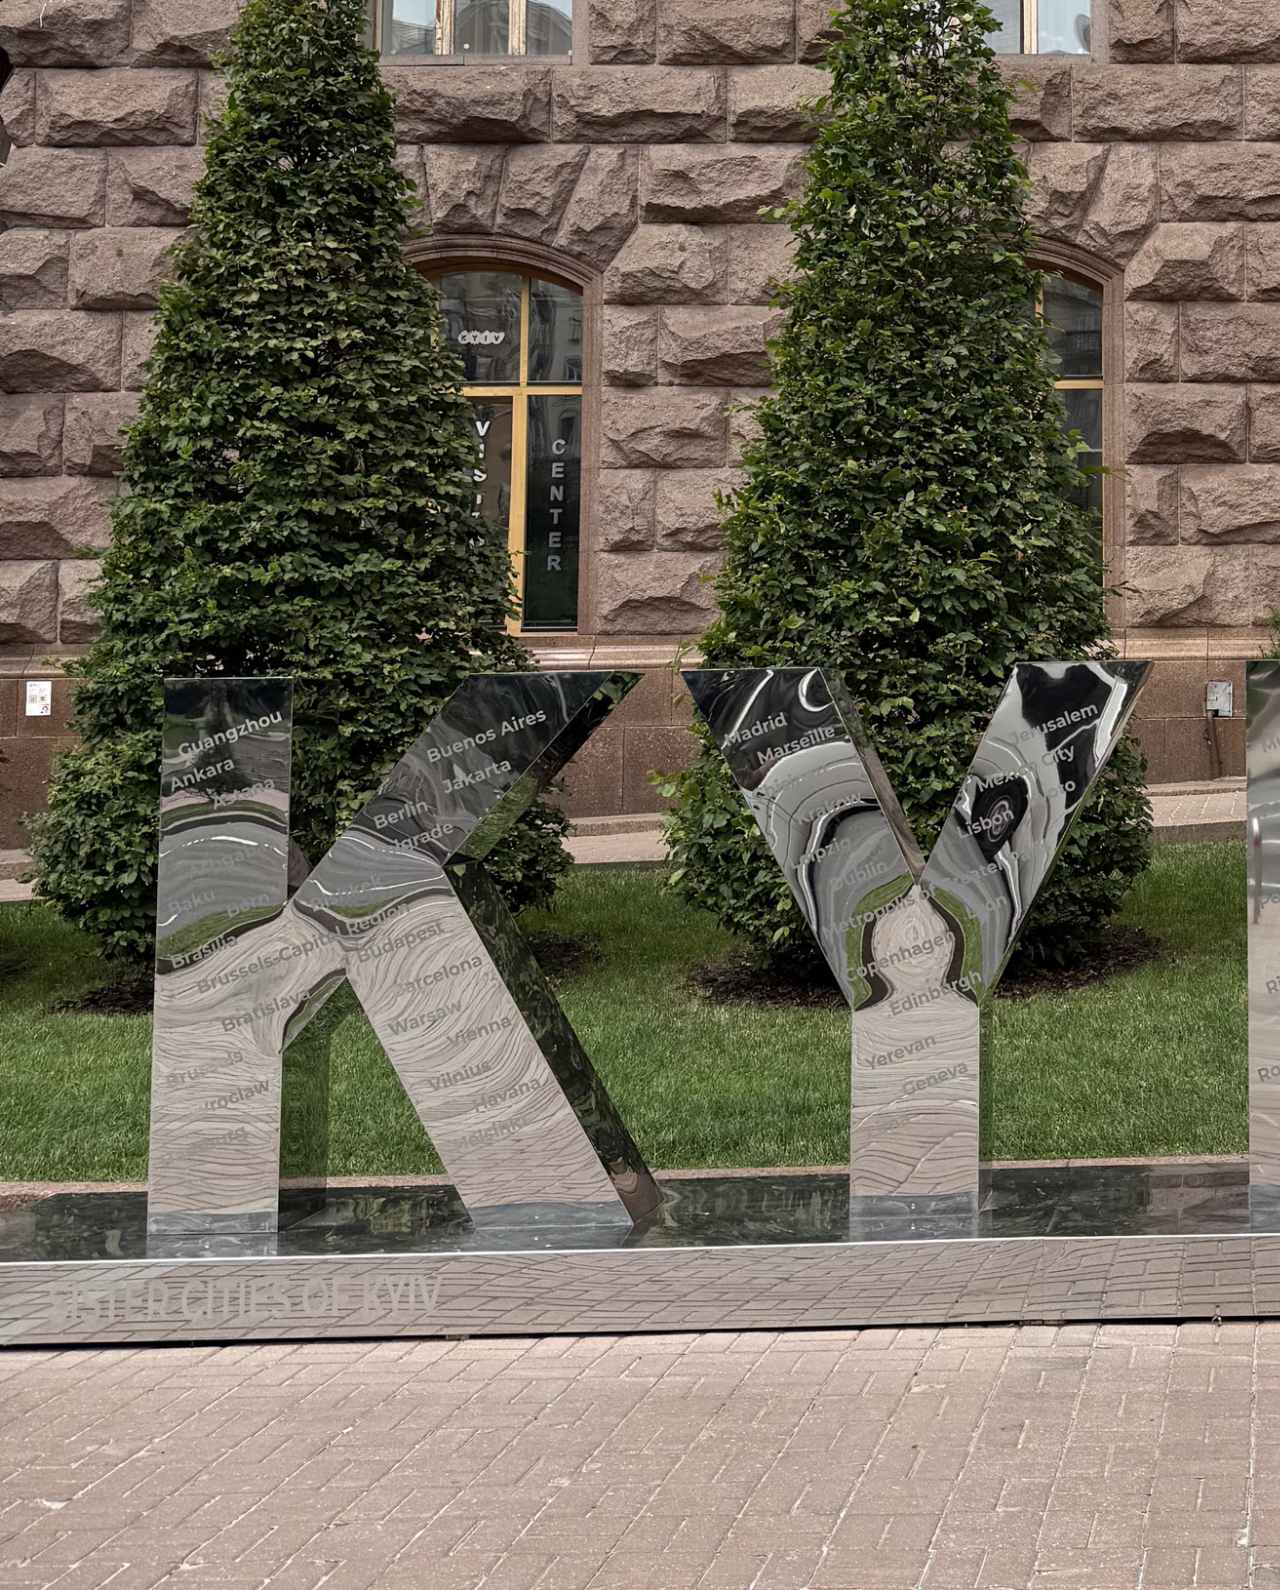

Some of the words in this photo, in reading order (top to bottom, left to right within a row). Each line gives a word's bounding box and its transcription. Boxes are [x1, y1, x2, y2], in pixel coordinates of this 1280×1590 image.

[547, 439, 567, 571] CENTER
[177, 709, 283, 759] Guangzhou
[426, 727, 497, 763] Buenos
[500, 708, 548, 739] Aires
[724, 712, 788, 747] Madrid
[1009, 704, 1099, 745] Jerusalem
[756, 727, 836, 764] Marseille
[170, 756, 235, 793] Ankara
[443, 757, 512, 794] Jakarta
[976, 762, 1038, 792] Mexio
[1042, 745, 1075, 766] City
[213, 777, 276, 810] Astana
[373, 800, 429, 830] Berlin
[956, 809, 1015, 838] Lisbon
[830, 859, 888, 892] Dublin
[167, 890, 216, 914] Baku
[226, 893, 270, 918] Bern
[821, 893, 916, 938] Metropolis
[919, 883, 937, 900] of
[965, 895, 1008, 921] Lon
[170, 934, 238, 969] Brasilia
[357, 919, 446, 964] Budapest
[845, 929, 956, 983] Copenhagen
[221, 989, 311, 1033] Bratislava
[890, 969, 983, 1018] Edinburgh
[387, 1001, 462, 1036] Warsaw
[447, 1015, 512, 1047] Vienna
[864, 1035, 937, 1070] Yerevan
[427, 1060, 492, 1092] Vilnius
[901, 1061, 969, 1097] Geneva
[472, 1078, 541, 1113] Havana
[364, 1274, 443, 1313] KYIV
